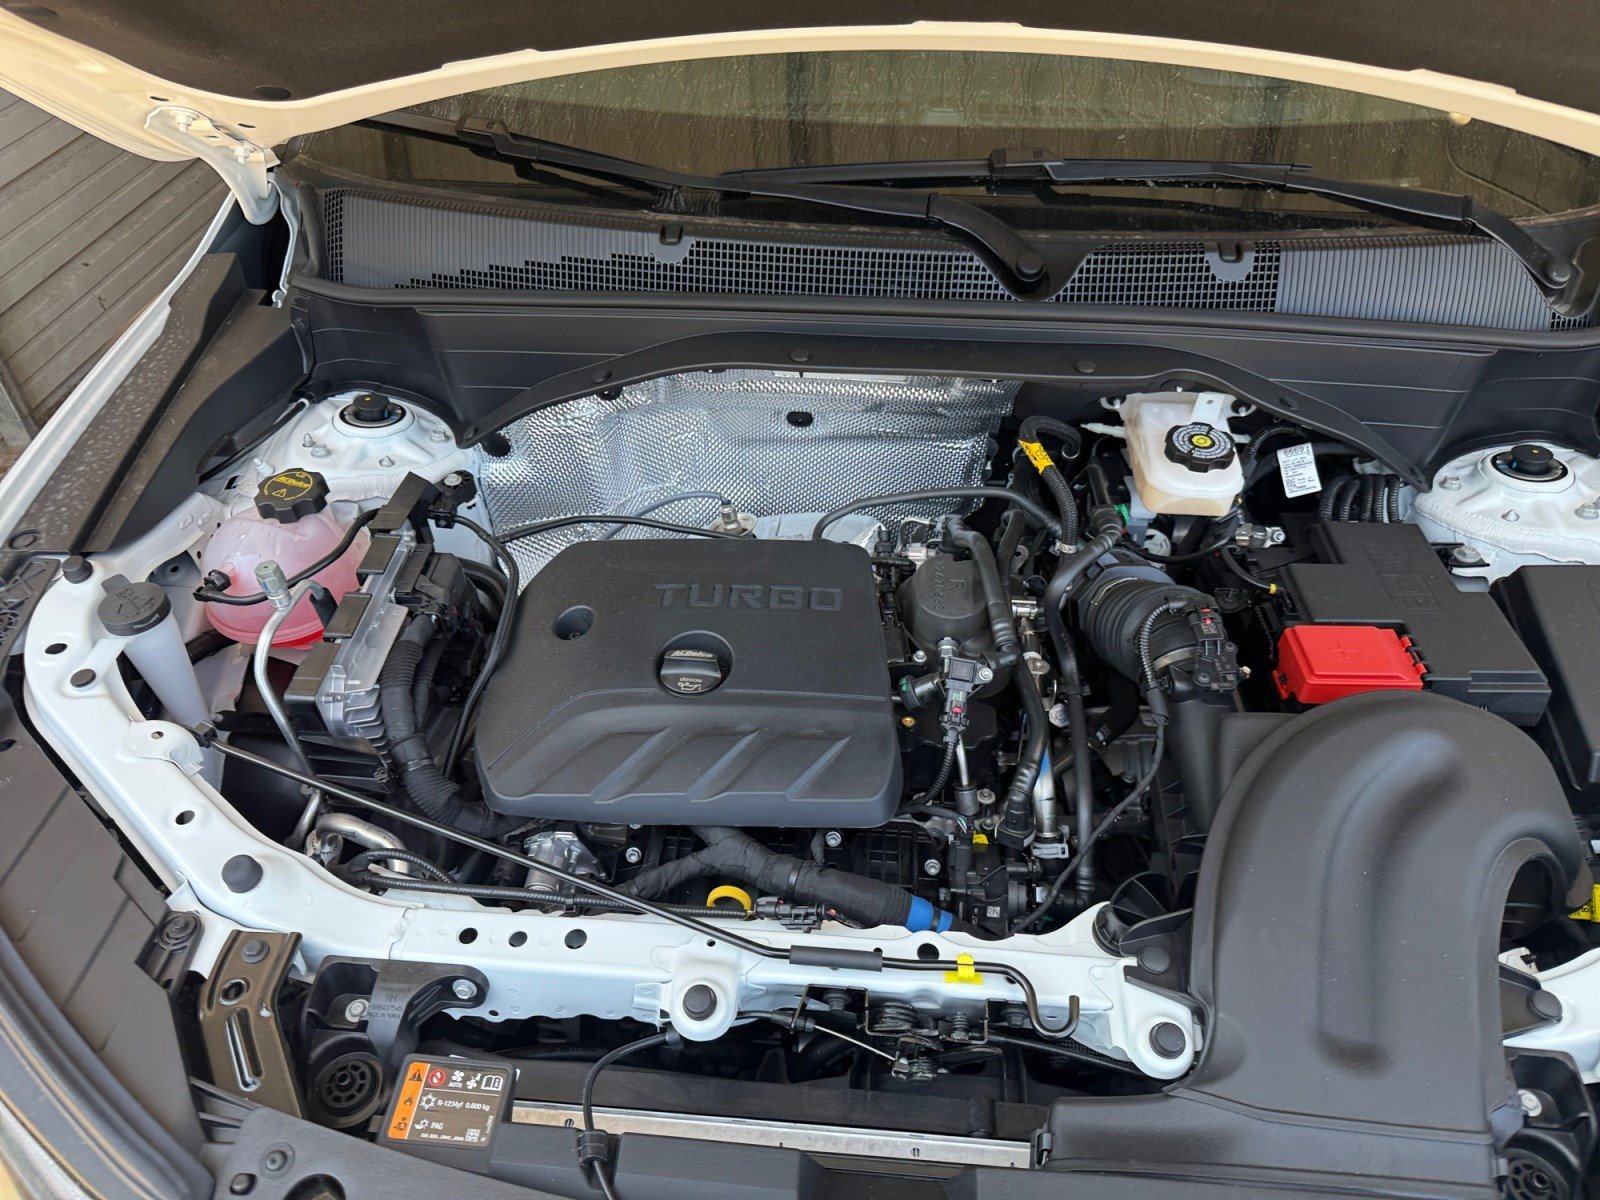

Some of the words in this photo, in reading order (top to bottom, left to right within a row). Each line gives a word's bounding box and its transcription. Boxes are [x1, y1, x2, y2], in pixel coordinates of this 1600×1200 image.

[653, 583, 842, 612] TURBO
[671, 650, 714, 658] ACDelco
[437, 1099, 464, 1109] R-1234yf
[482, 1103, 490, 1112] kg
[431, 1121, 444, 1130] PAG
